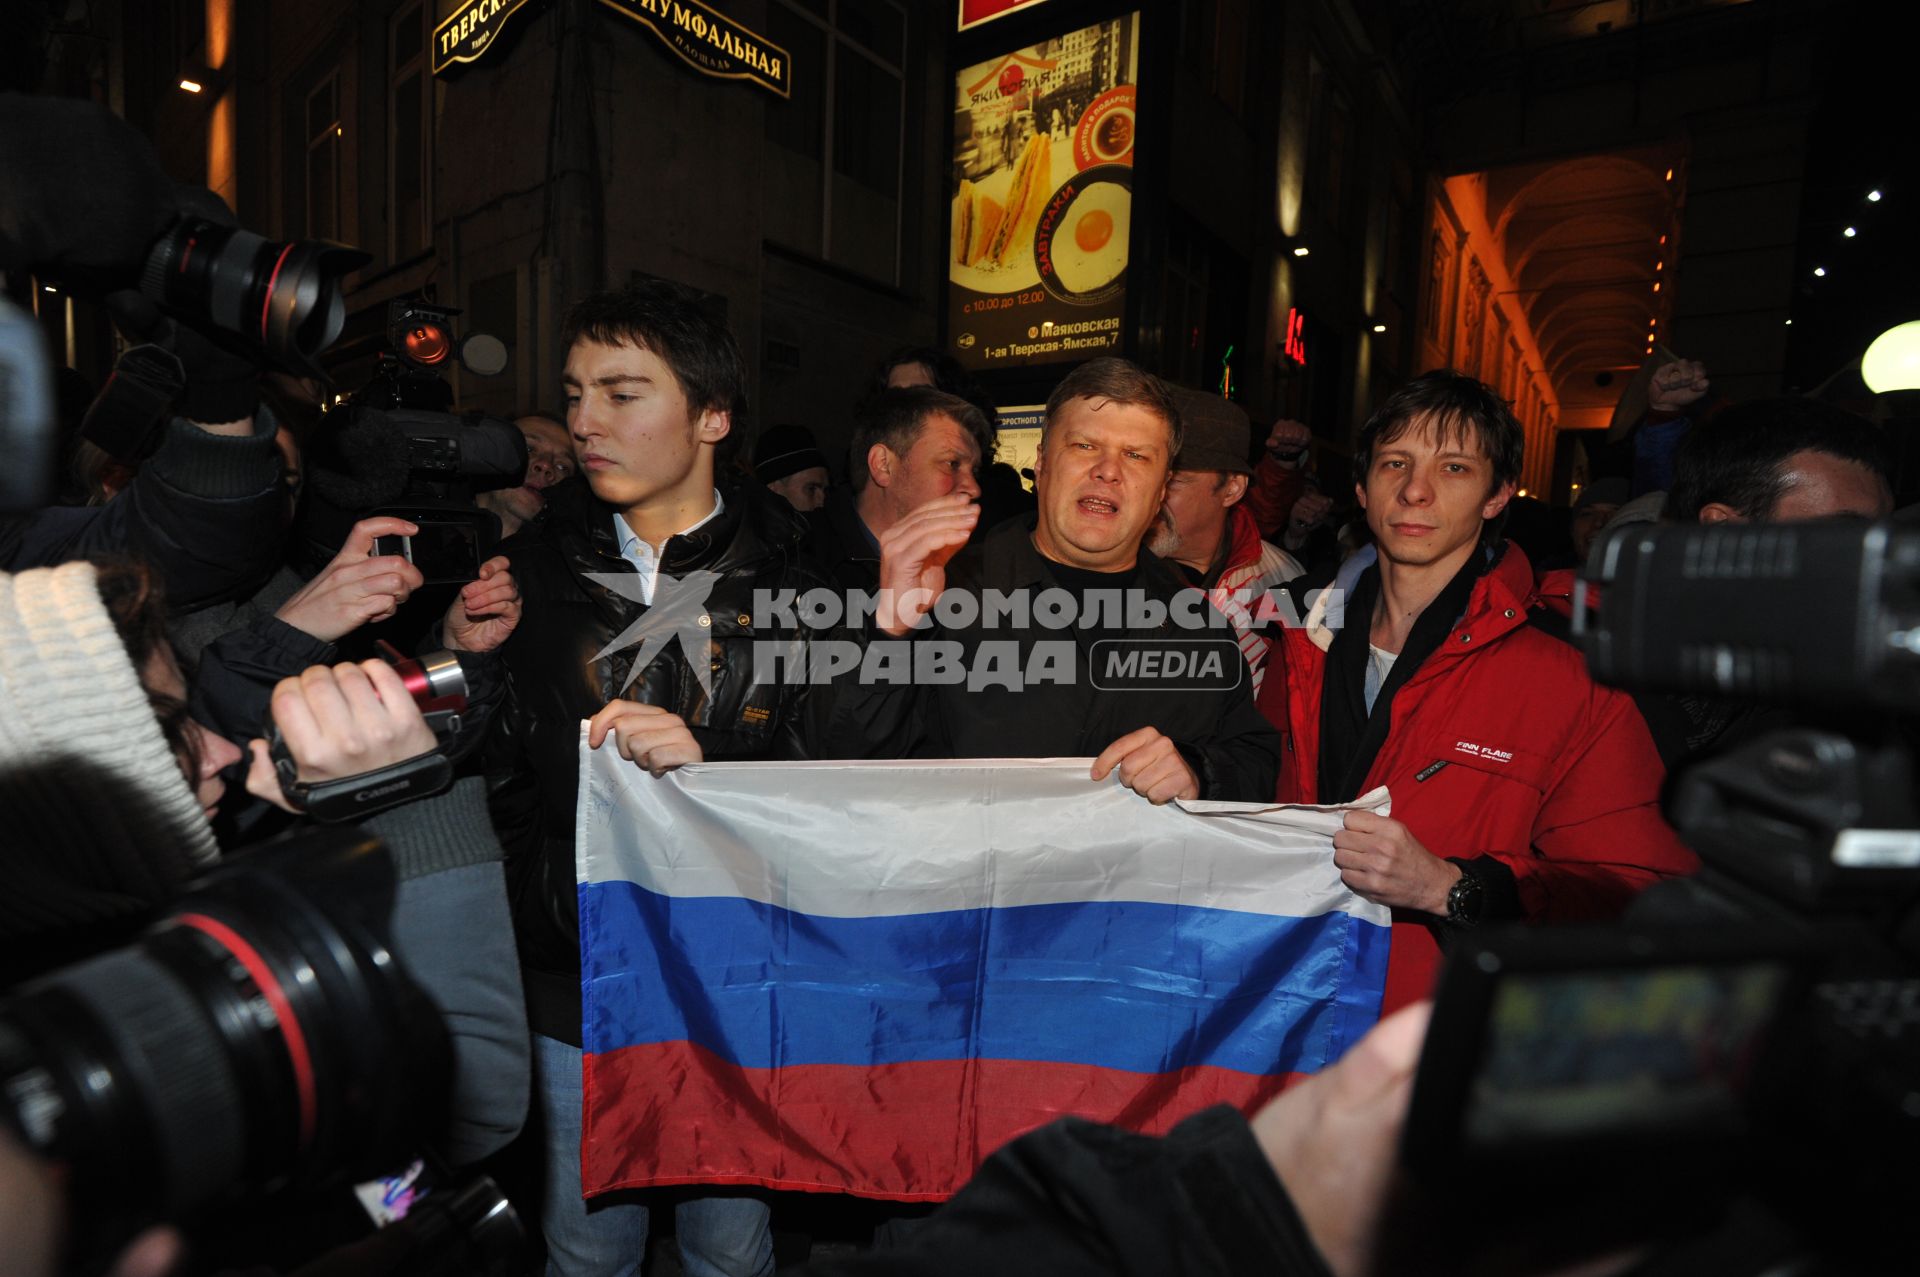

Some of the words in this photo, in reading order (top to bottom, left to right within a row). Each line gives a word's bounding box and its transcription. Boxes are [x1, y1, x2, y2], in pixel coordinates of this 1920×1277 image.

[440, 0, 511, 55] ТВЕРСК
[631, 0, 781, 80] ИУМФАЛЬНАЯ
[1037, 184, 1076, 277] ЗАВТРАКИ
[974, 299, 999, 313] 10.00
[1001, 297, 1014, 310] до
[1018, 291, 1045, 305] 12.00
[1041, 316, 1120, 338] Маяковская
[984, 346, 1007, 359] 1-ая
[1456, 741, 1480, 751] FINN
[1481, 747, 1513, 759] FLARE
[353, 778, 411, 802] Canon
